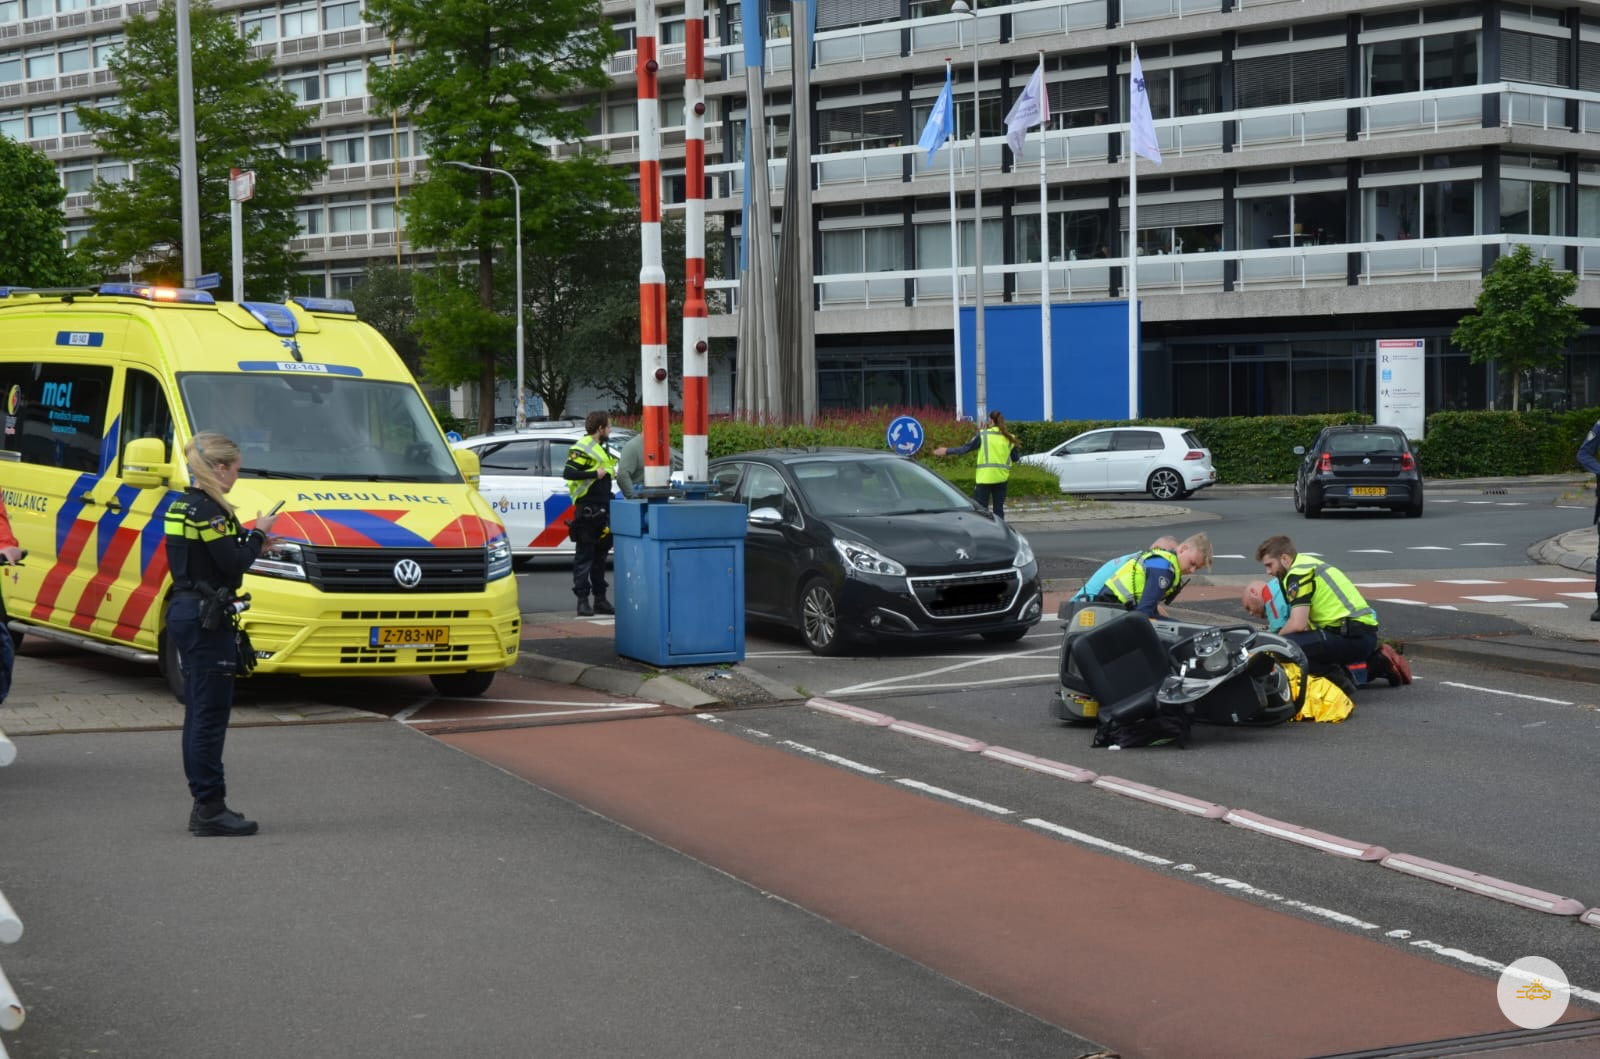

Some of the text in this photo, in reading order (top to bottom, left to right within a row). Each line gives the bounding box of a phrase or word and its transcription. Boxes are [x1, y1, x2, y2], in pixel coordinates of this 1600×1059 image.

[284, 363, 321, 371] 02-143
[41, 382, 73, 408] mcl
[1, 489, 48, 512] MBULANCE
[297, 492, 450, 505] AMBULANCE
[492, 495, 542, 513] POLITIE
[383, 628, 444, 643] Z-783-NP
